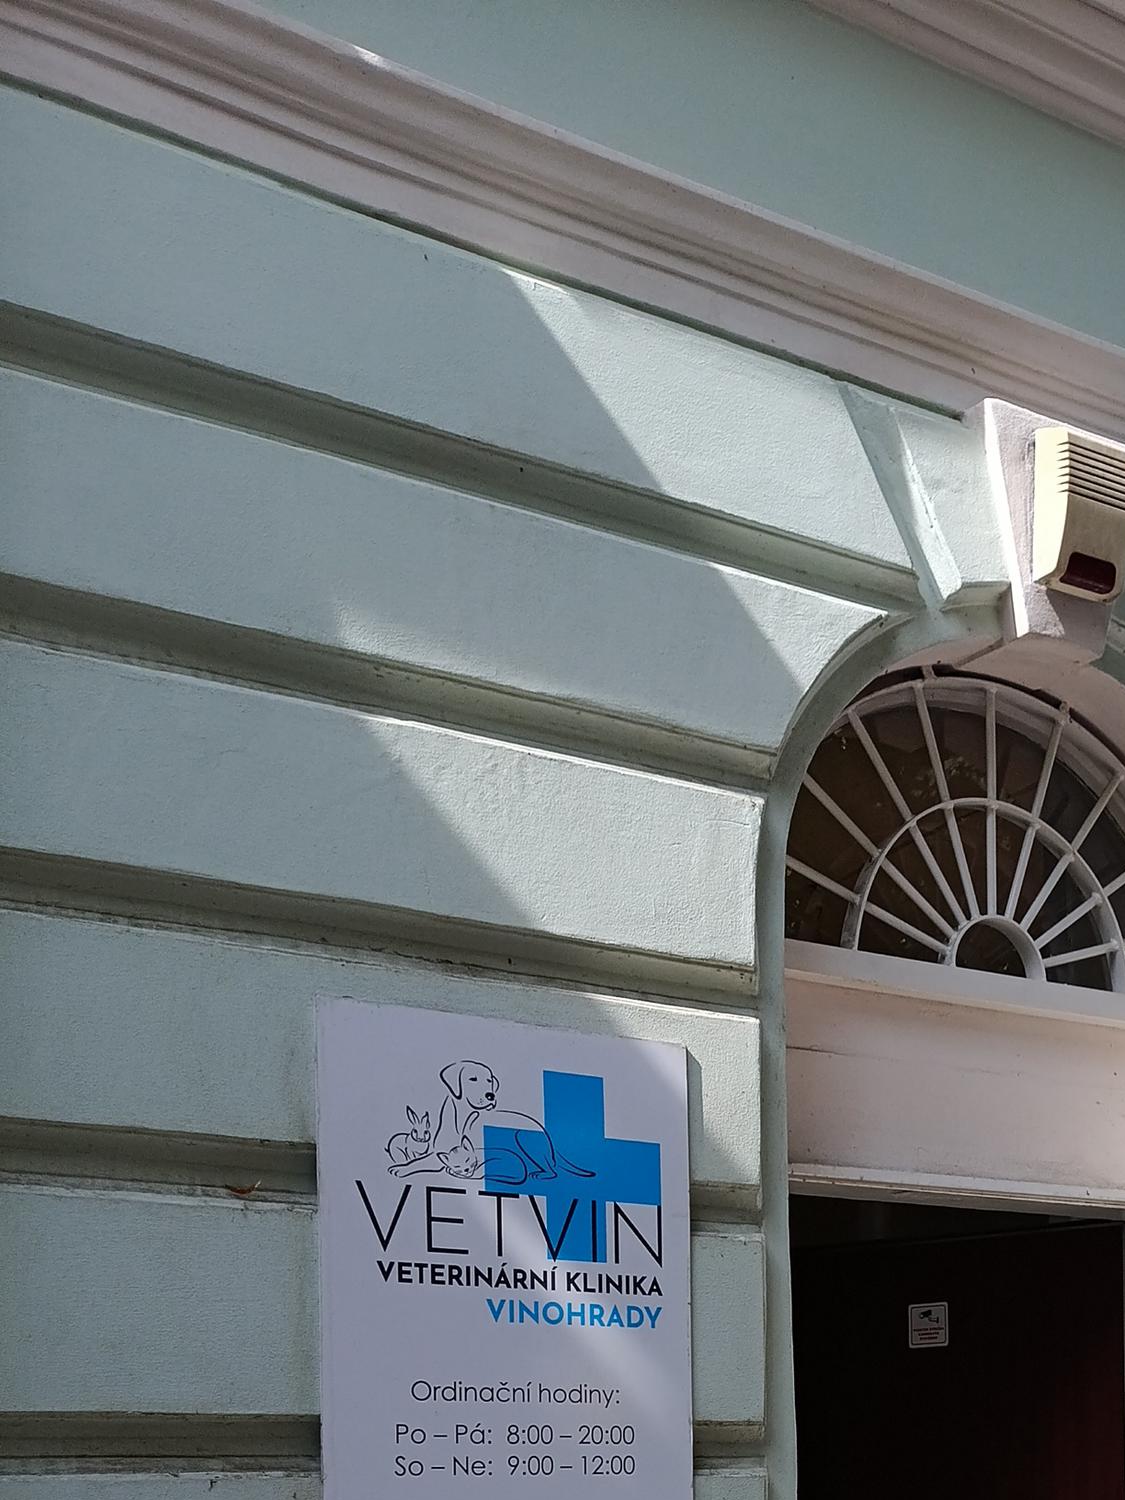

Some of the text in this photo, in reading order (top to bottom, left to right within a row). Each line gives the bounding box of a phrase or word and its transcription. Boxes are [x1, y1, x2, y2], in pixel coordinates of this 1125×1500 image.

[355, 1179, 663, 1268] VETVIN
[376, 1259, 664, 1297] VETERINÁRNÍ KLINIKA
[485, 1298, 663, 1329] VINOHRADY
[410, 1380, 621, 1409] Ordinační hodiny:
[395, 1423, 427, 1445] Po
[455, 1422, 493, 1445] Pá:
[506, 1424, 554, 1445] 8:00
[578, 1424, 635, 1445] 20:00
[394, 1455, 424, 1477] So
[452, 1455, 493, 1476] Ne:
[507, 1455, 554, 1476] 9:00
[581, 1455, 636, 1476] 12:00
